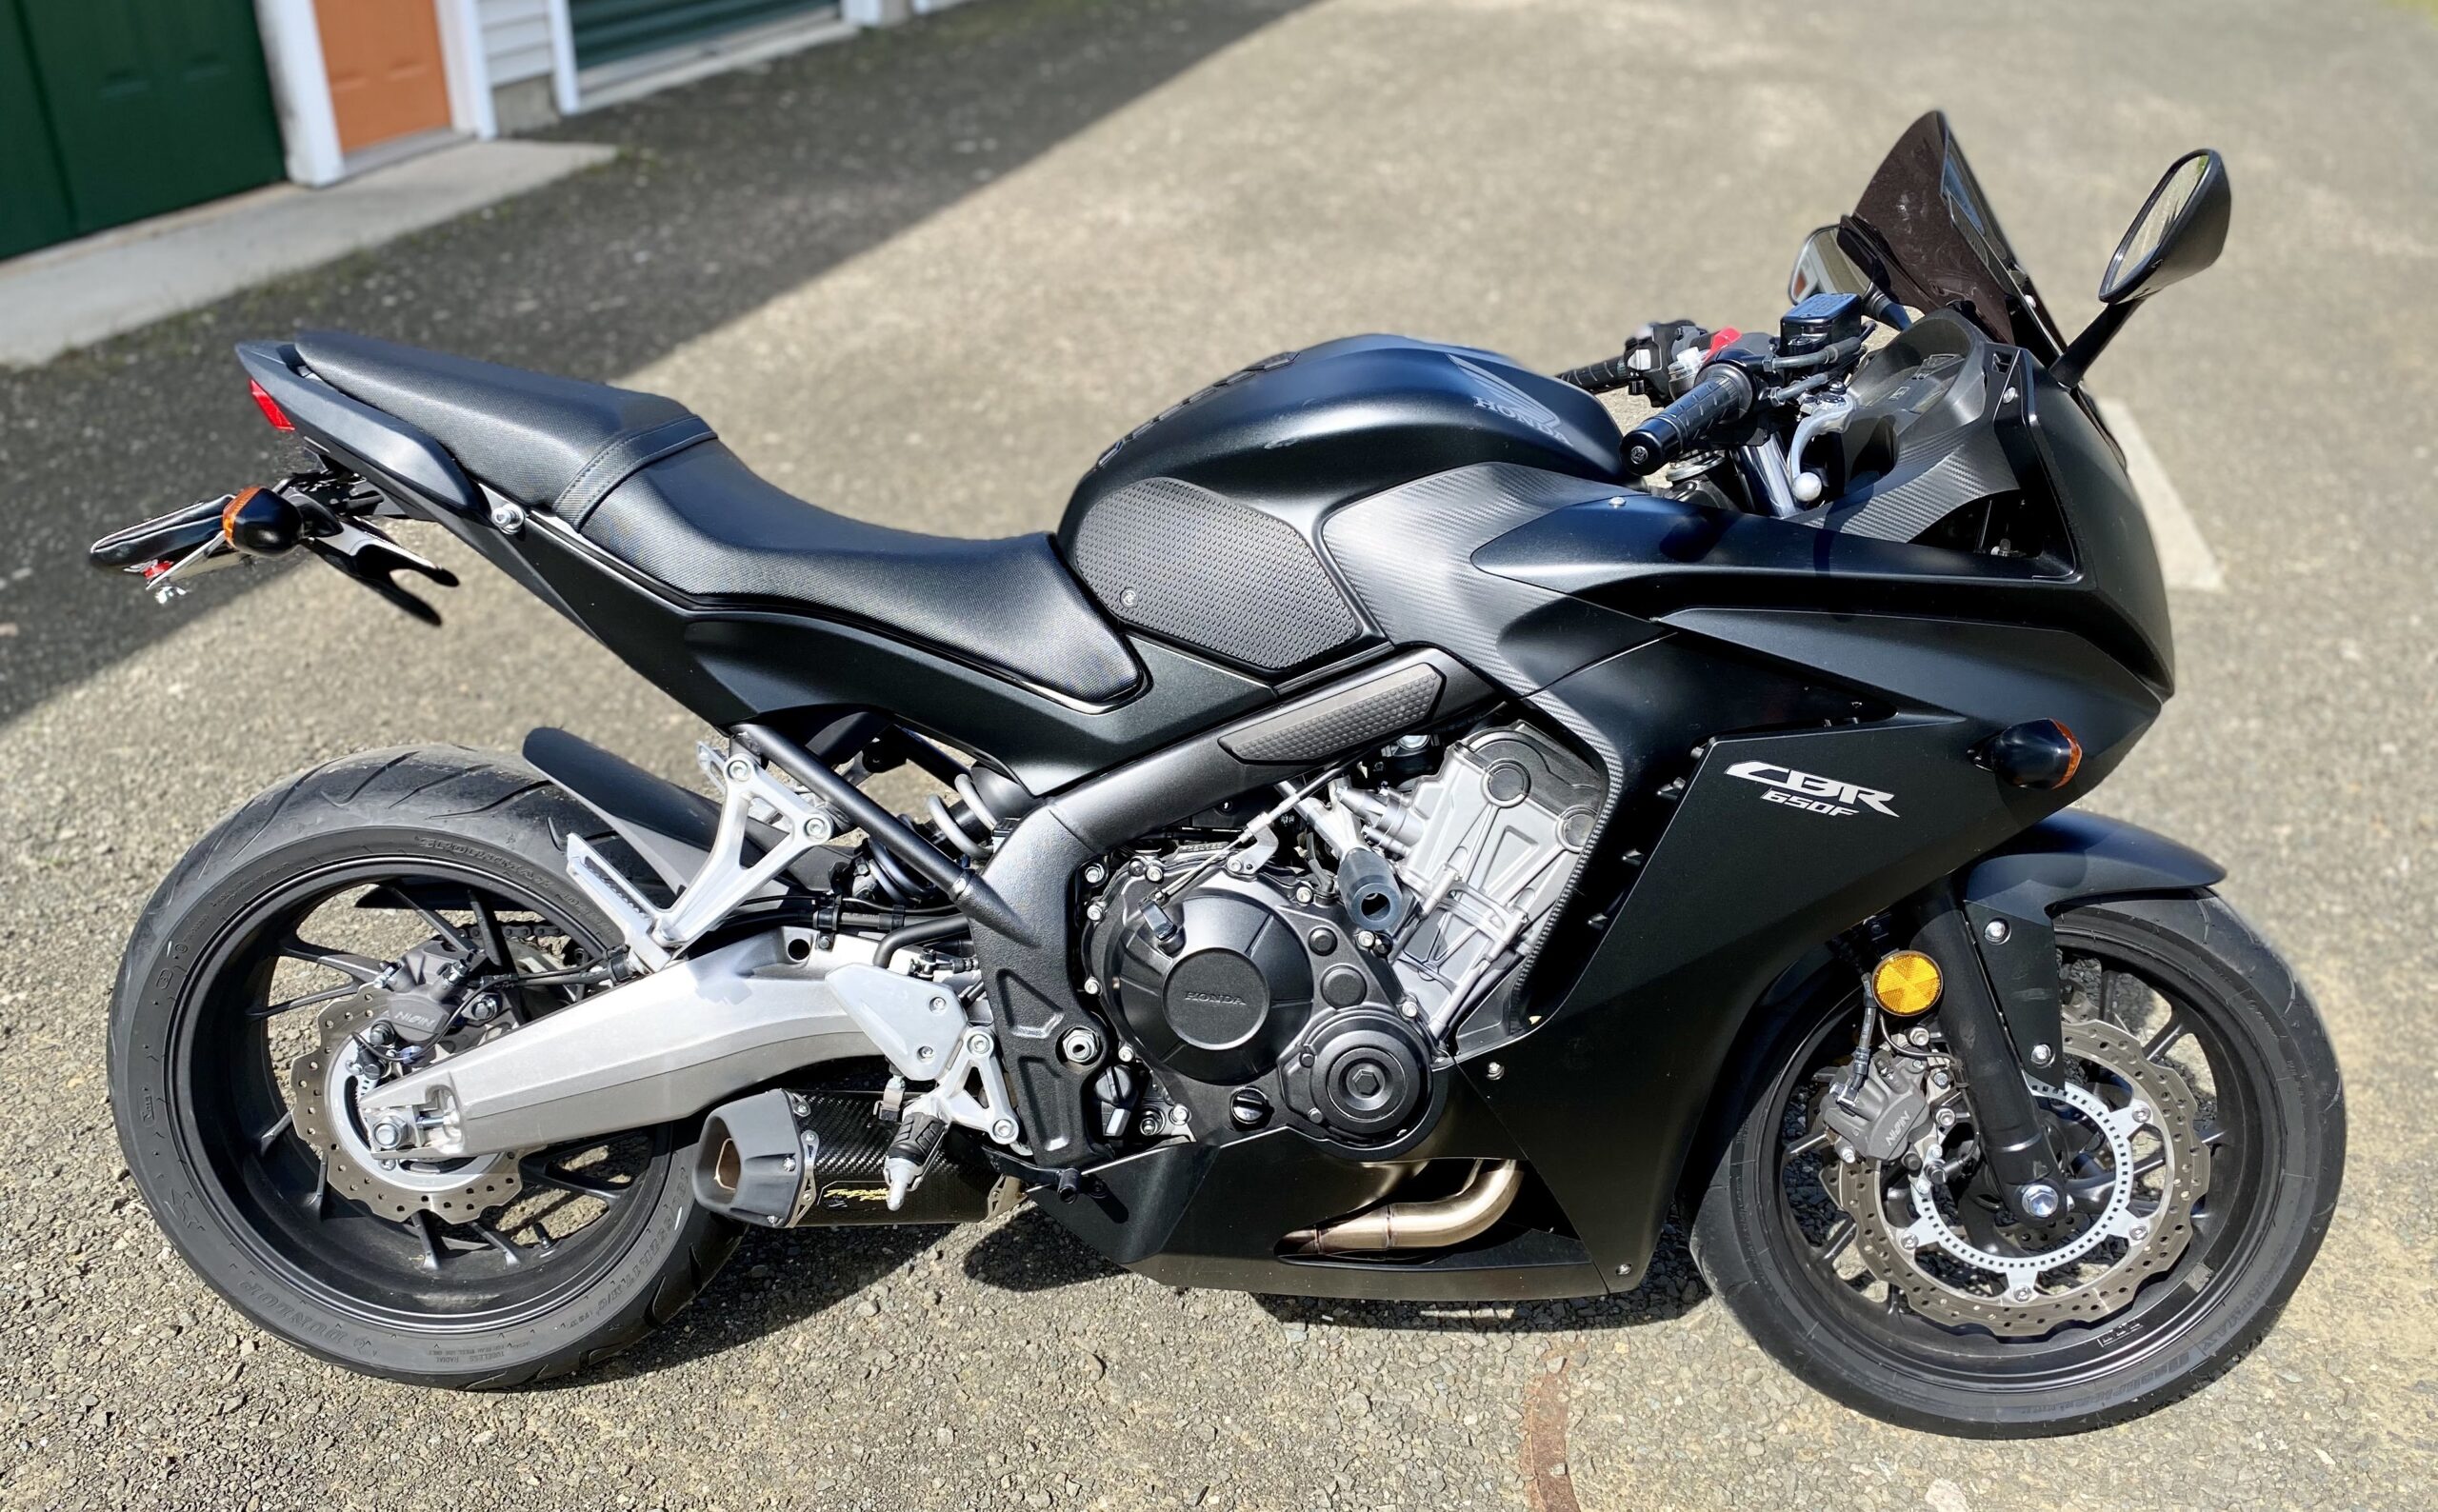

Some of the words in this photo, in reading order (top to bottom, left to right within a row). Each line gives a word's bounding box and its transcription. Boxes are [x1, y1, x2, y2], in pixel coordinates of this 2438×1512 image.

[1473, 396, 1574, 448] HONDA
[1725, 761, 1901, 818] CBR
[1761, 789, 1860, 817] 650F
[1185, 991, 1247, 1005] HONDA
[236, 1273, 348, 1347] DUNLOP
